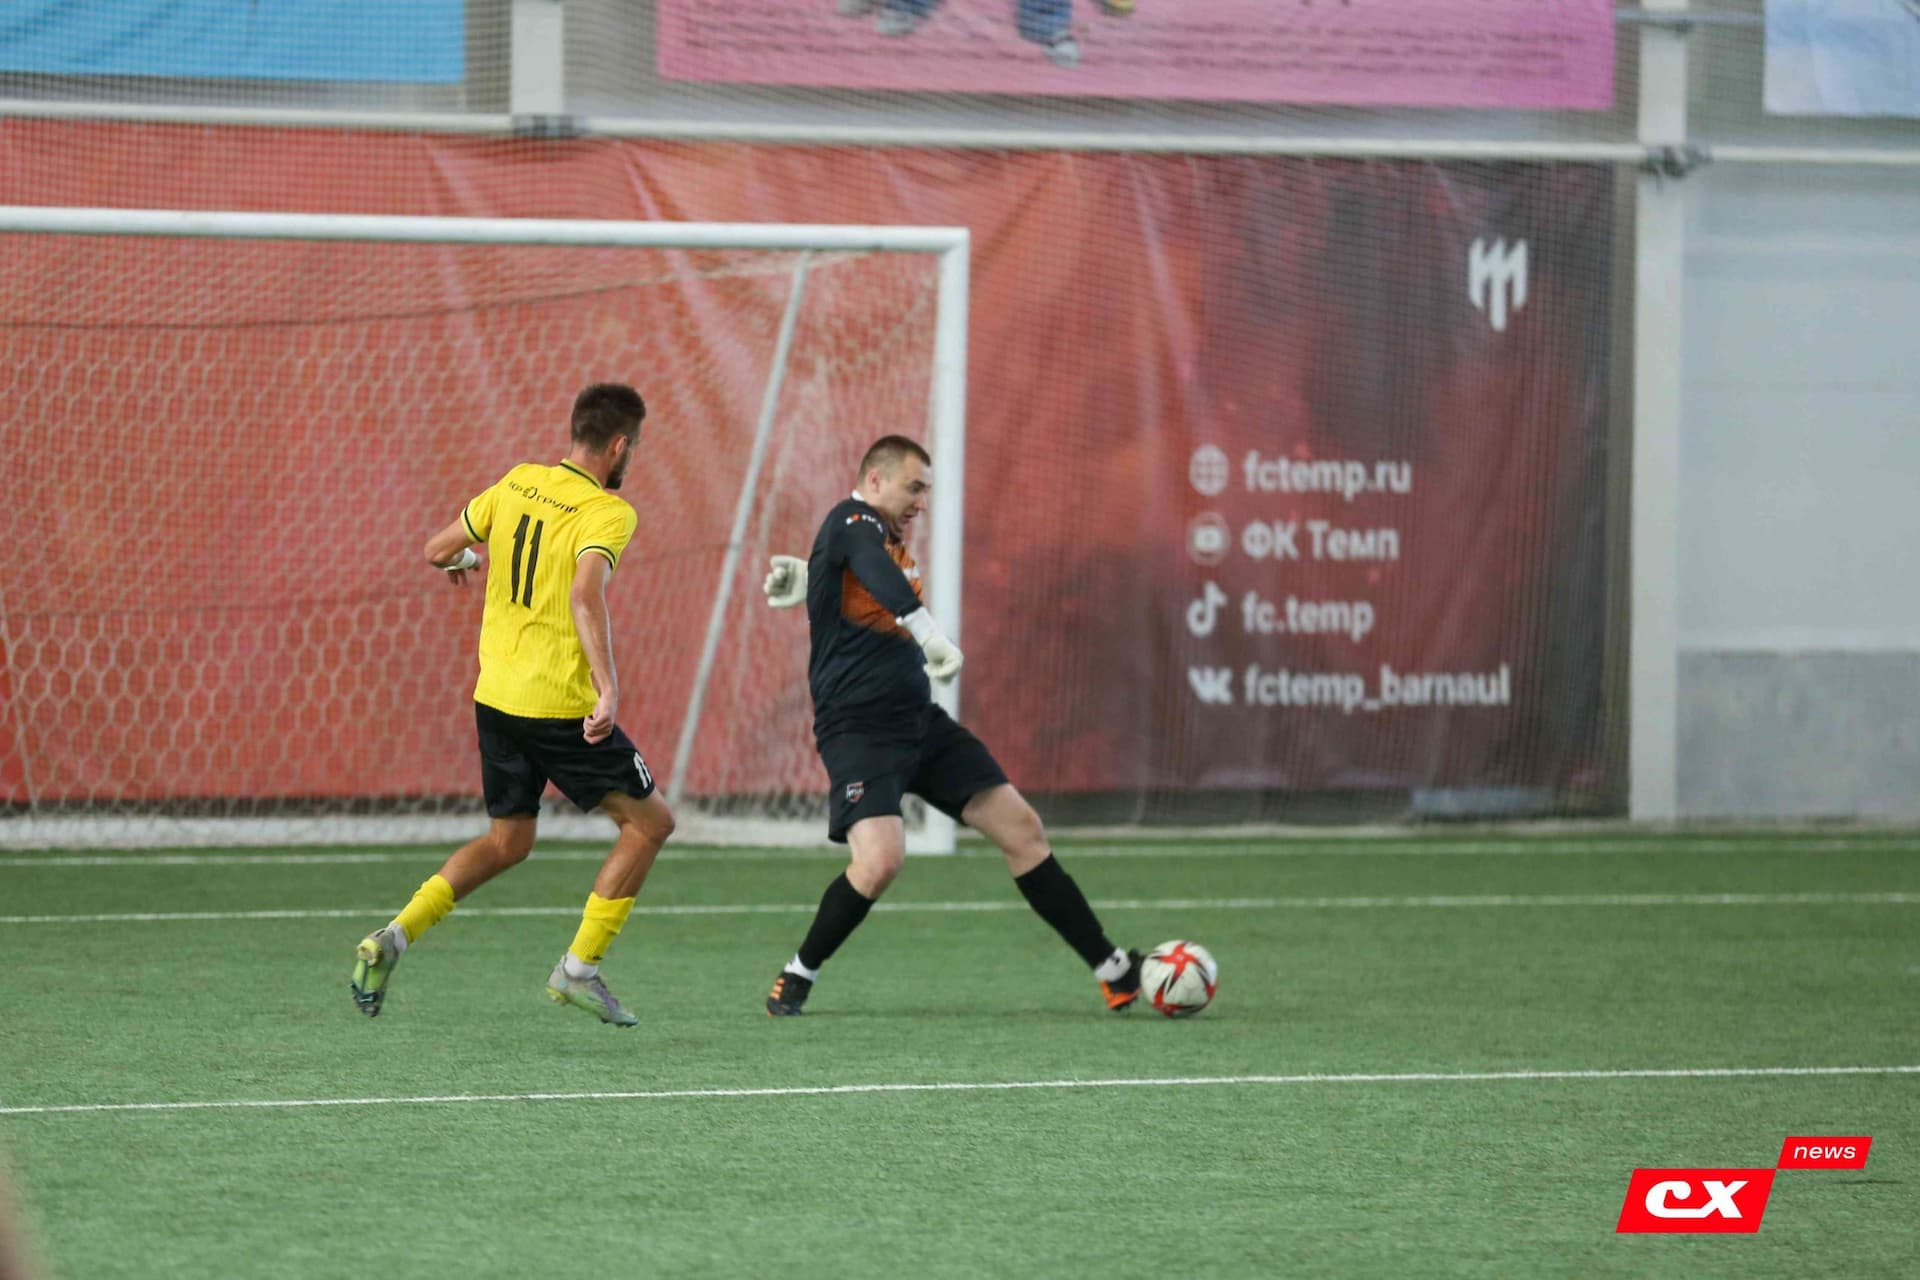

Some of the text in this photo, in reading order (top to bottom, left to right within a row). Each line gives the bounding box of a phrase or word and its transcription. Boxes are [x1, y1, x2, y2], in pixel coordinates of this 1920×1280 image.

[1244, 450, 1412, 501] fctemp.ru
[512, 513, 544, 609] 11
[1242, 519, 1400, 561] ФК Темп
[1243, 590, 1375, 642] fc.temp
[1244, 663, 1511, 714] fctemp_barnaul
